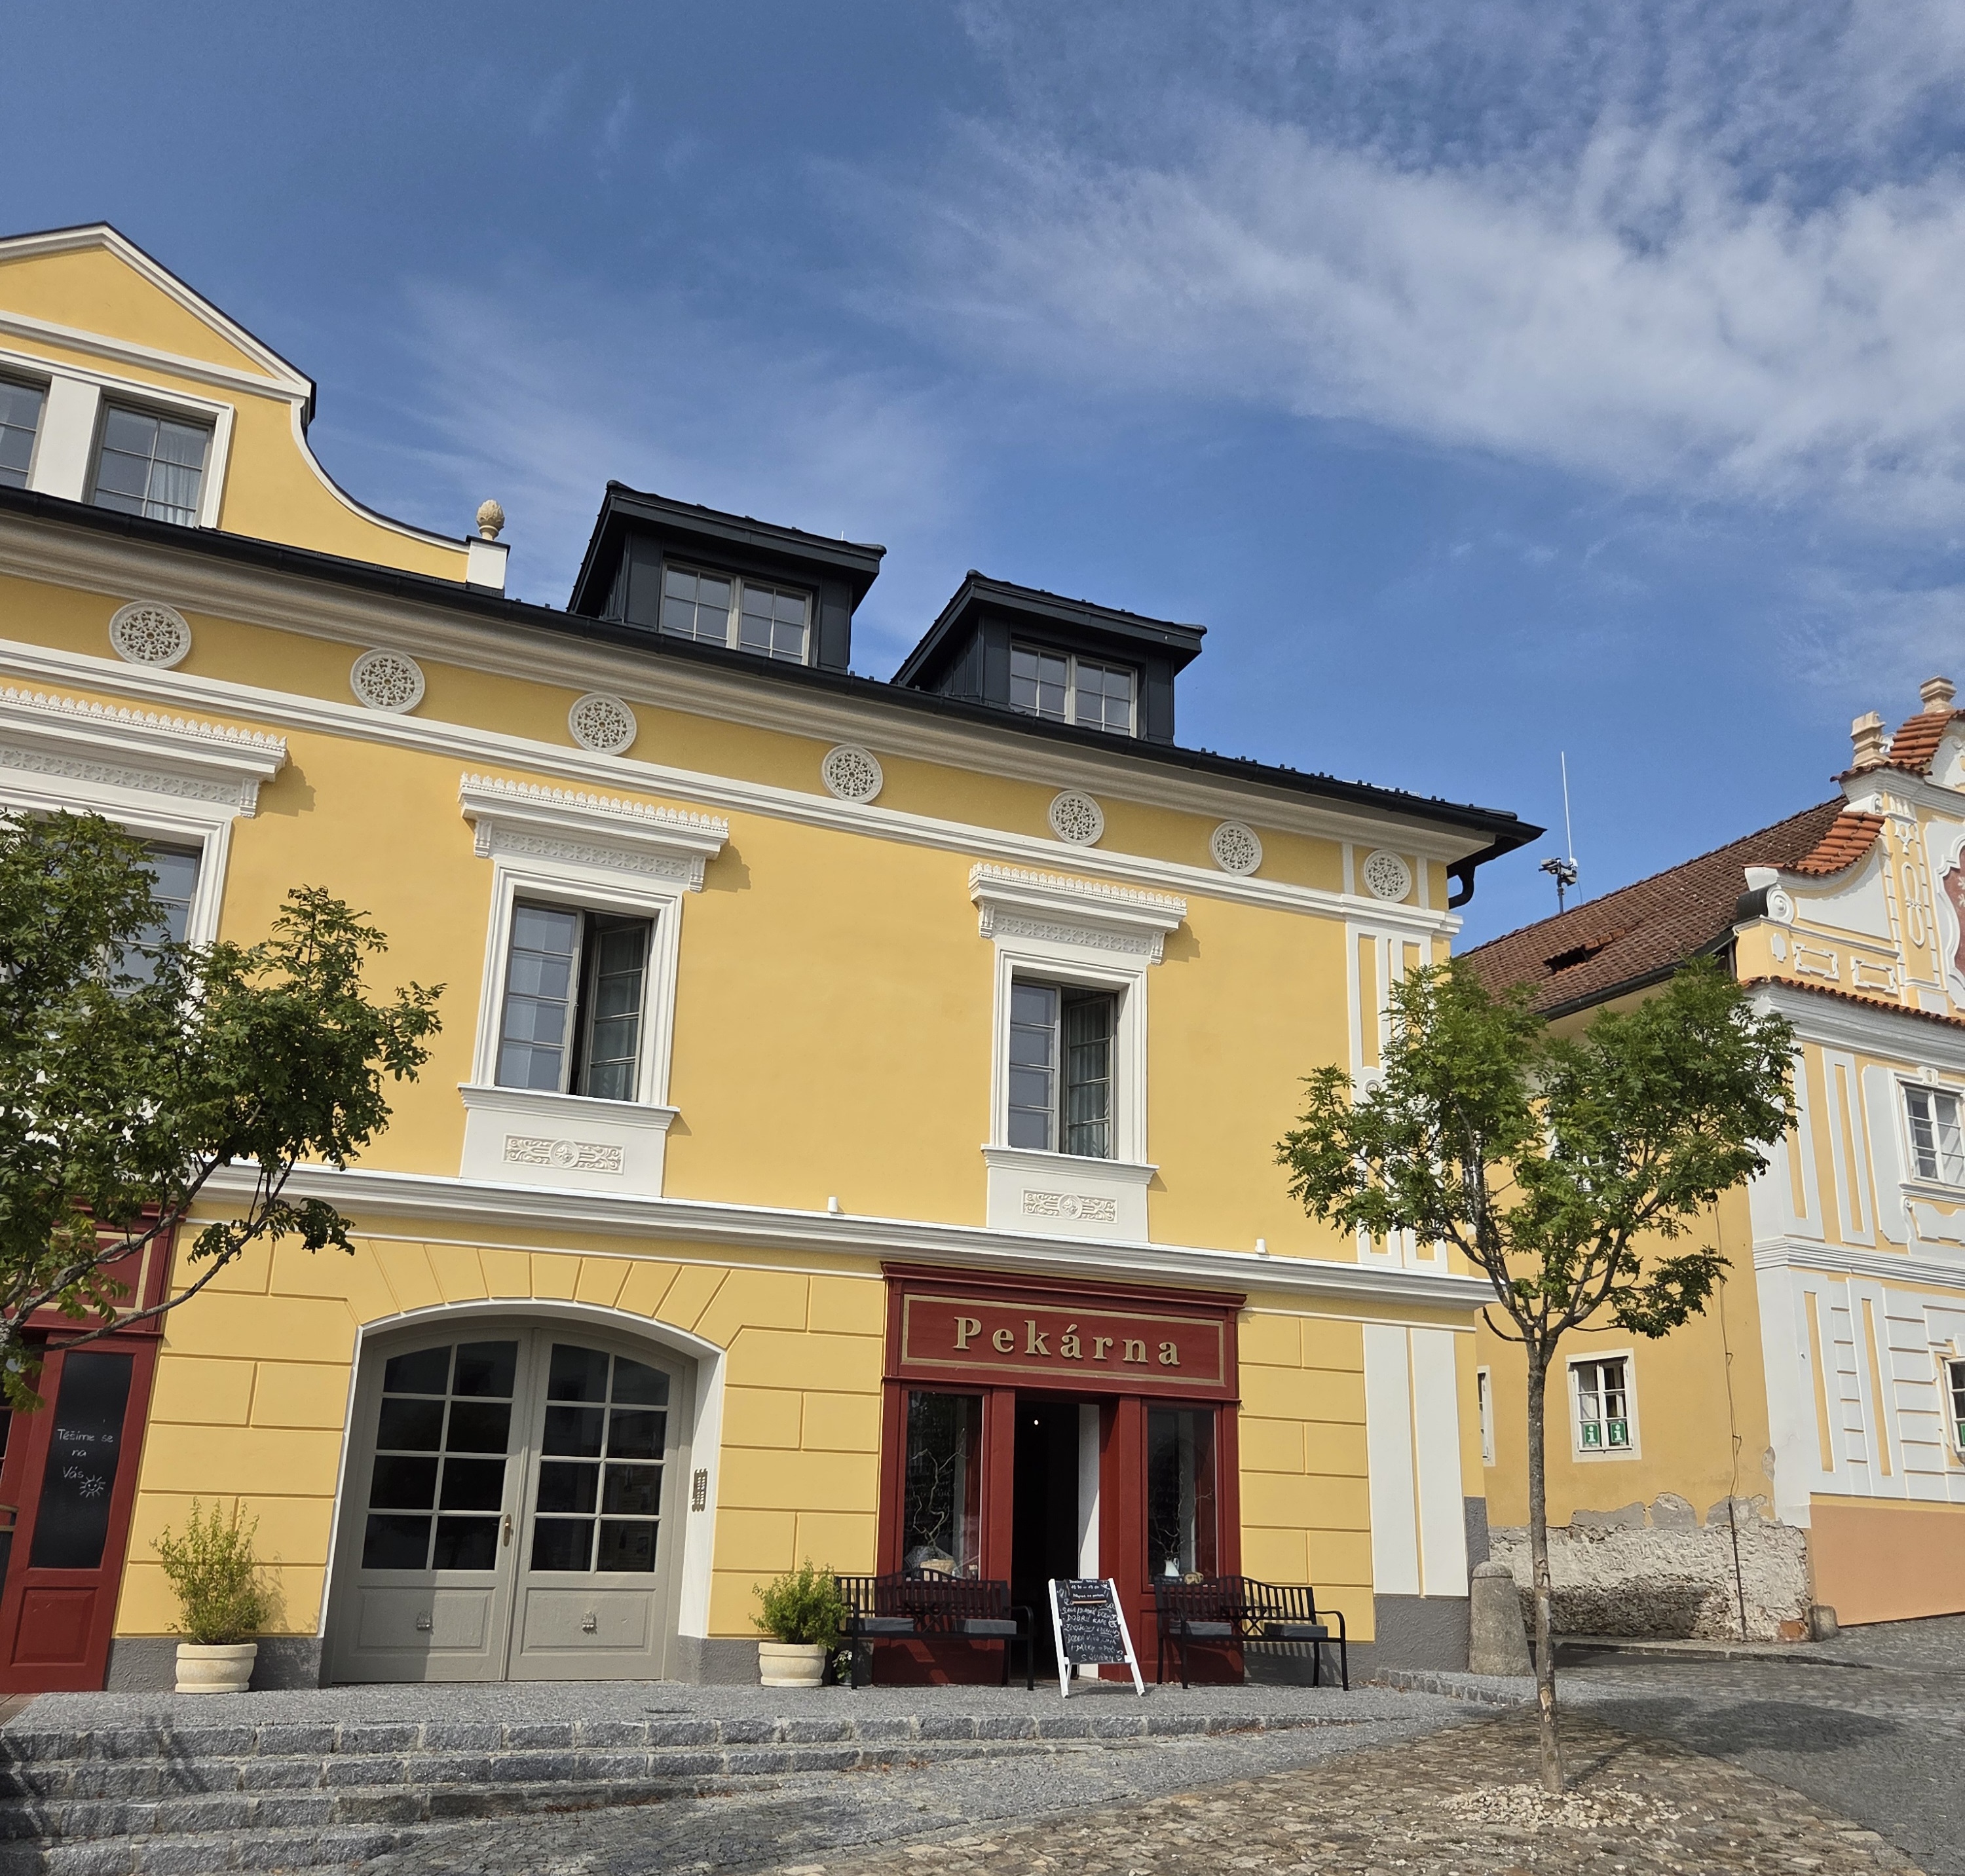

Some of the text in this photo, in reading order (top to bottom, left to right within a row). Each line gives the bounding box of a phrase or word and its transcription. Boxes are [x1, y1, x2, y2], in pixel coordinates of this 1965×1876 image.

[952, 1317, 1180, 1364] Pekárna
[1587, 1426, 1596, 1442] i
[1614, 1425, 1622, 1440] i
[63, 1466, 84, 1478] Vás
